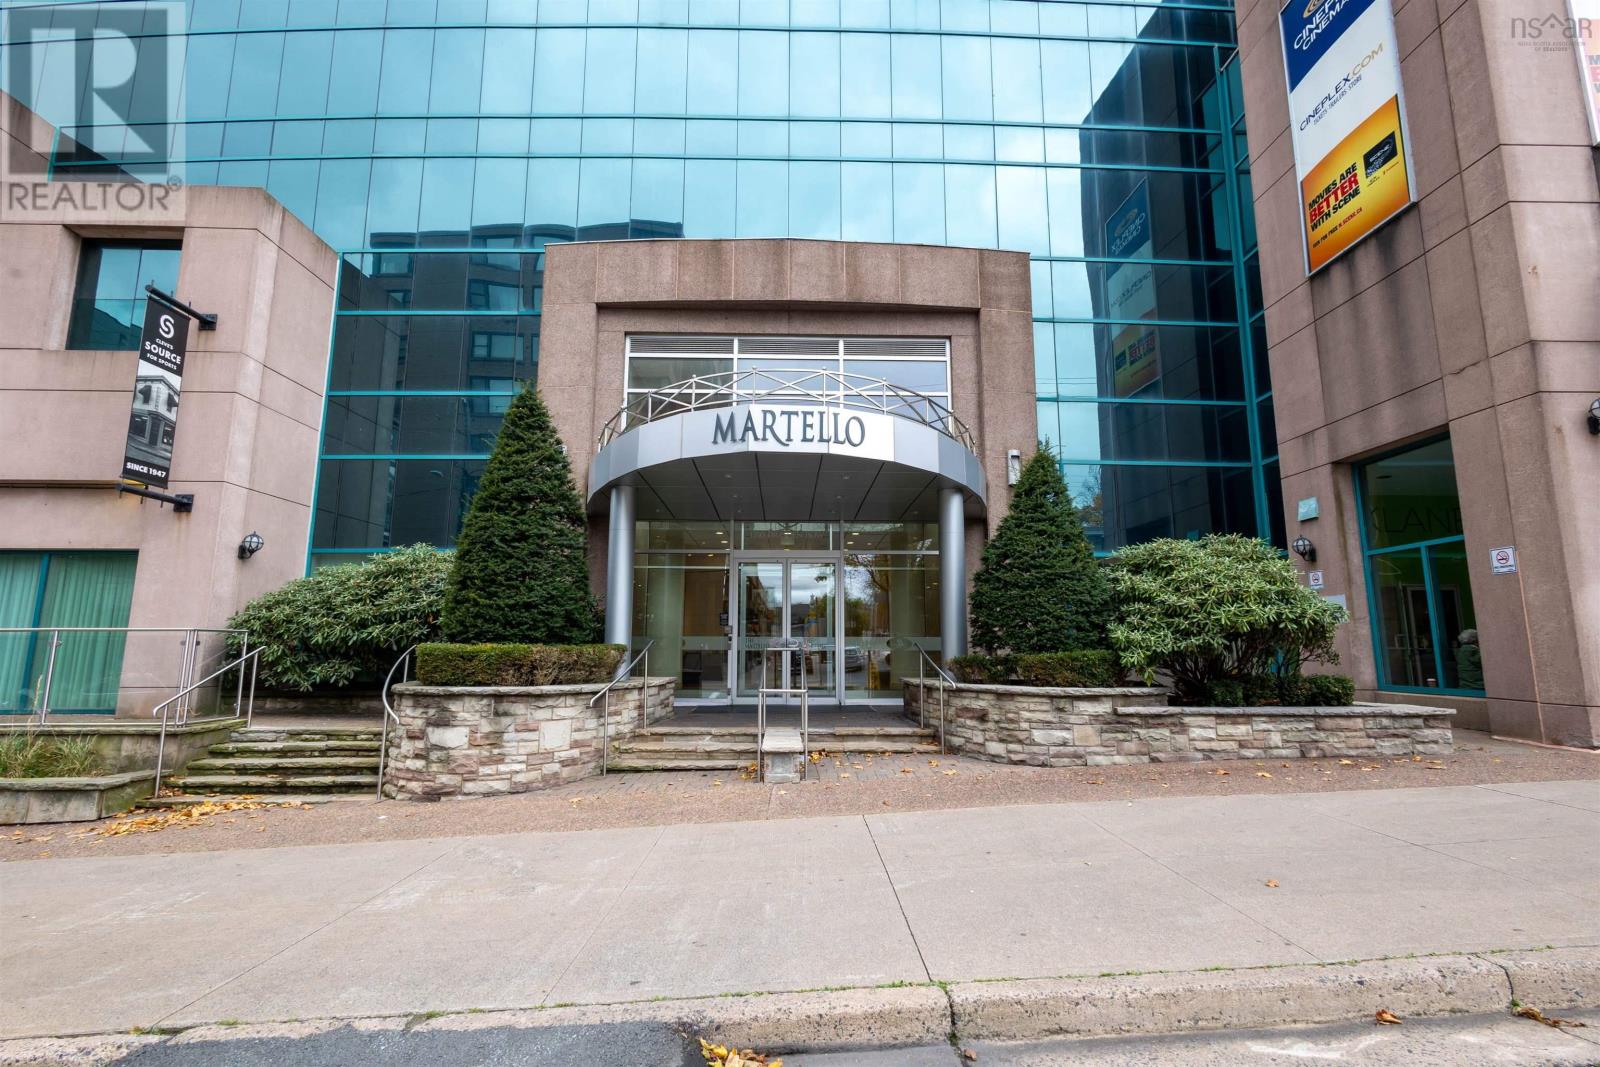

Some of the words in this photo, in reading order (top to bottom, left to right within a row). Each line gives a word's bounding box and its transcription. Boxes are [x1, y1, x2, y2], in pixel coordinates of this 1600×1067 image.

[1293, 0, 1335, 49] CINEP
[1300, 42, 1384, 131] CINEPLEX.COM
[1309, 180, 1337, 211] MOVIES
[1339, 162, 1357, 183] ARE
[1310, 172, 1359, 225] BETTER
[1311, 209, 1331, 232] WITH
[1332, 185, 1361, 214] SCENE
[144, 341, 182, 364] SOURCE
[147, 352, 158, 361] FOR
[158, 358, 177, 370] SPORTS
[712, 409, 866, 447] MARTELLO
[126, 462, 149, 473] SINCE
[148, 467, 166, 478] 1947
